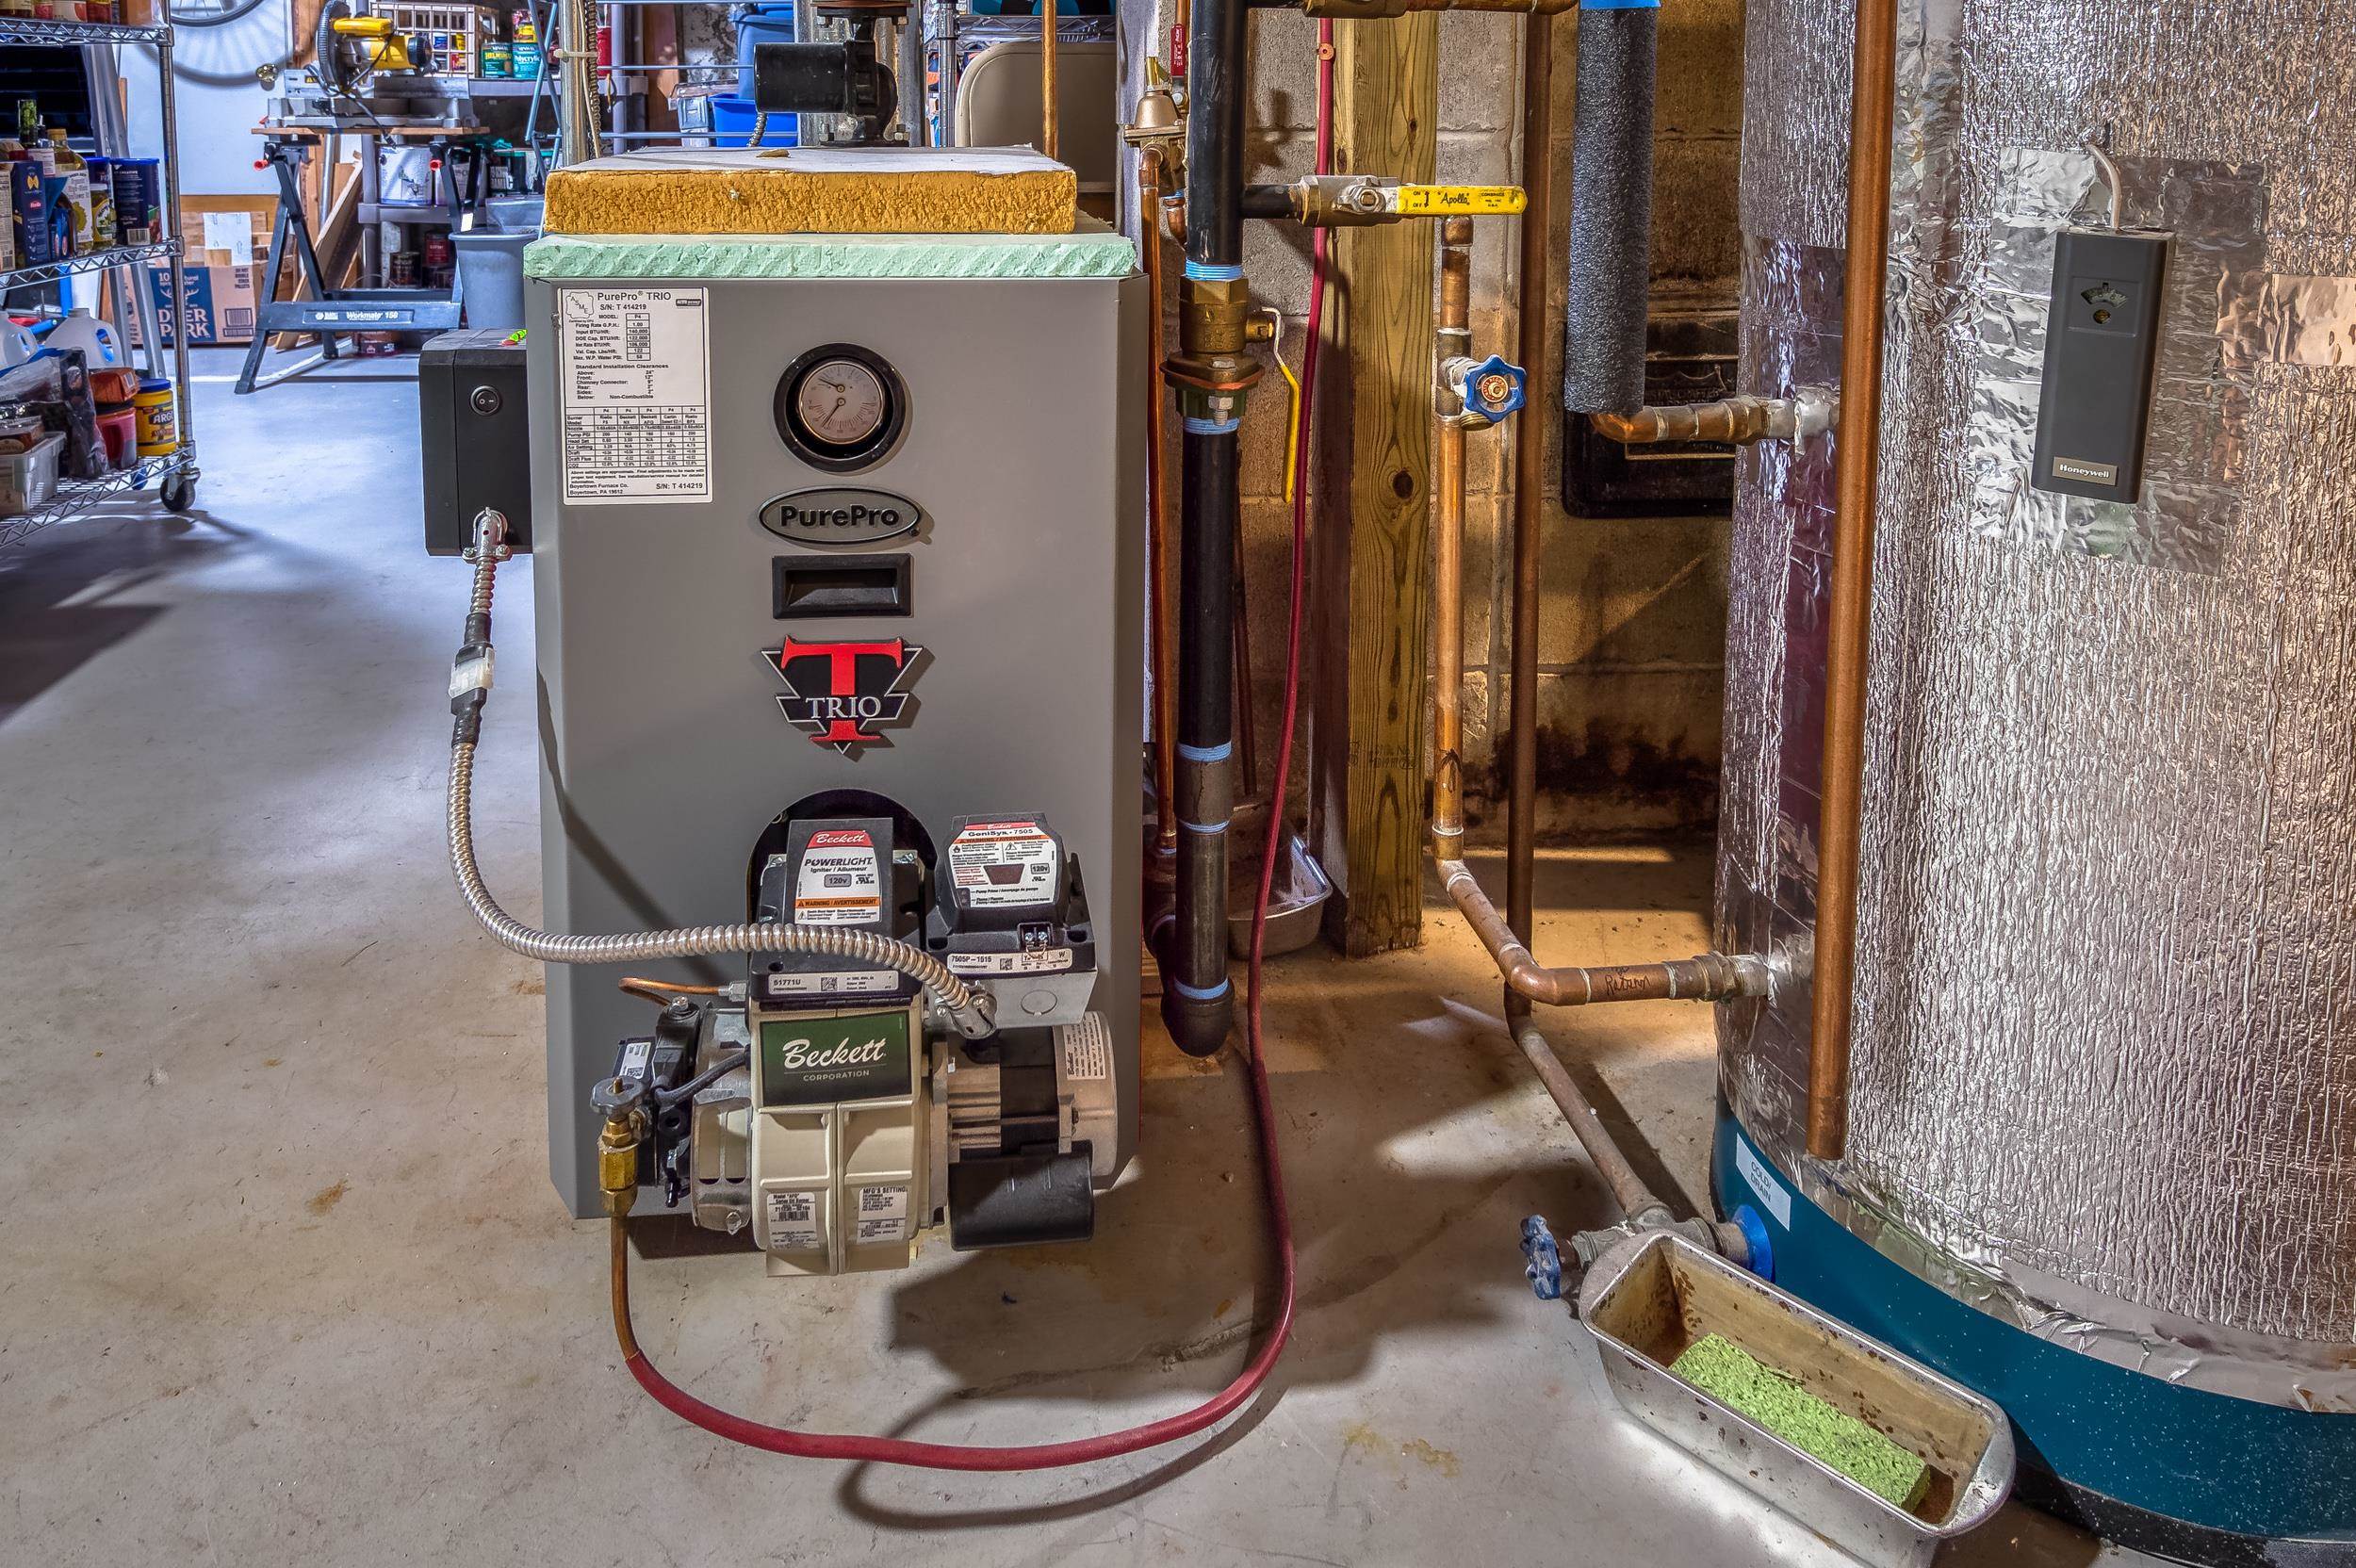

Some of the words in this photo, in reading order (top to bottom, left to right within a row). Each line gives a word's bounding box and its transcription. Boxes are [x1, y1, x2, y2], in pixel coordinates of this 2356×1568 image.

[646, 292, 671, 301] TRIO
[158, 309, 207, 322] DER
[160, 322, 211, 338] PRK
[2059, 464, 2109, 478] Honeywell
[779, 504, 900, 527] PurePro
[806, 696, 881, 719] TRIO
[816, 833, 864, 843] Beckett
[805, 857, 873, 867] POWERLIGHT
[782, 1037, 886, 1069] Beckett
[803, 1070, 869, 1082] CORPORATION
[1750, 1171, 1772, 1202] DRAIN
